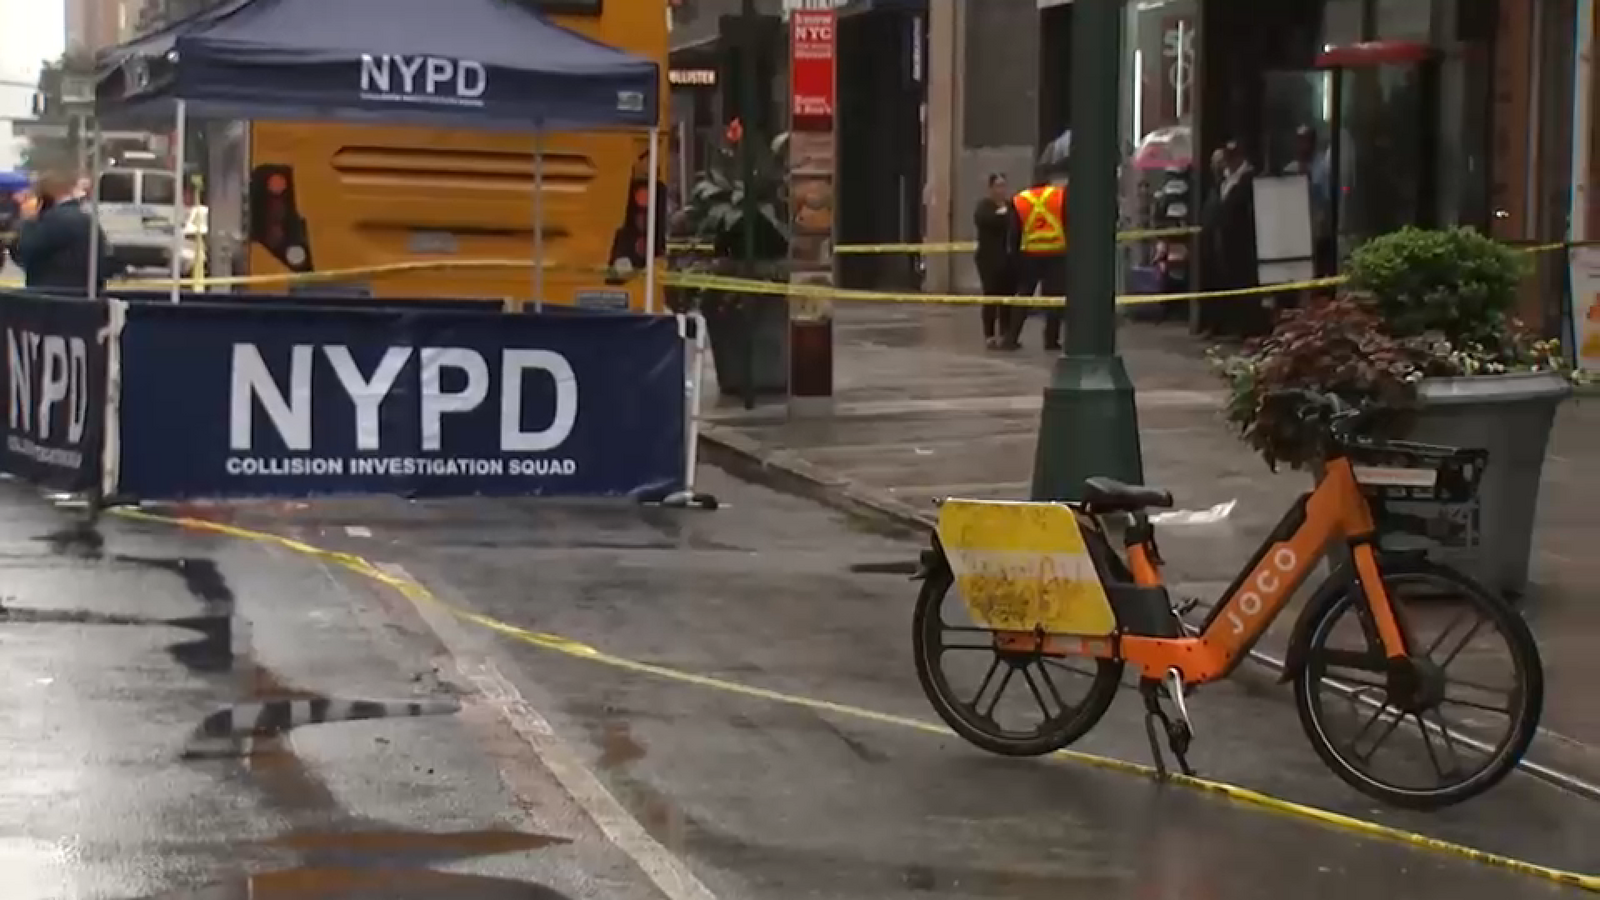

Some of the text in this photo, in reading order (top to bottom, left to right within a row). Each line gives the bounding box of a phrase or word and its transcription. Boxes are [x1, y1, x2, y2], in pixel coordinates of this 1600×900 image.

[795, 25, 832, 40] NYC
[360, 53, 487, 97] NYPD
[667, 69, 716, 85] OLLISTER
[229, 342, 578, 451] NYPD
[225, 456, 576, 475] COLLISION INVESTIGATION SQUAD
[1226, 547, 1297, 636] JOCO
